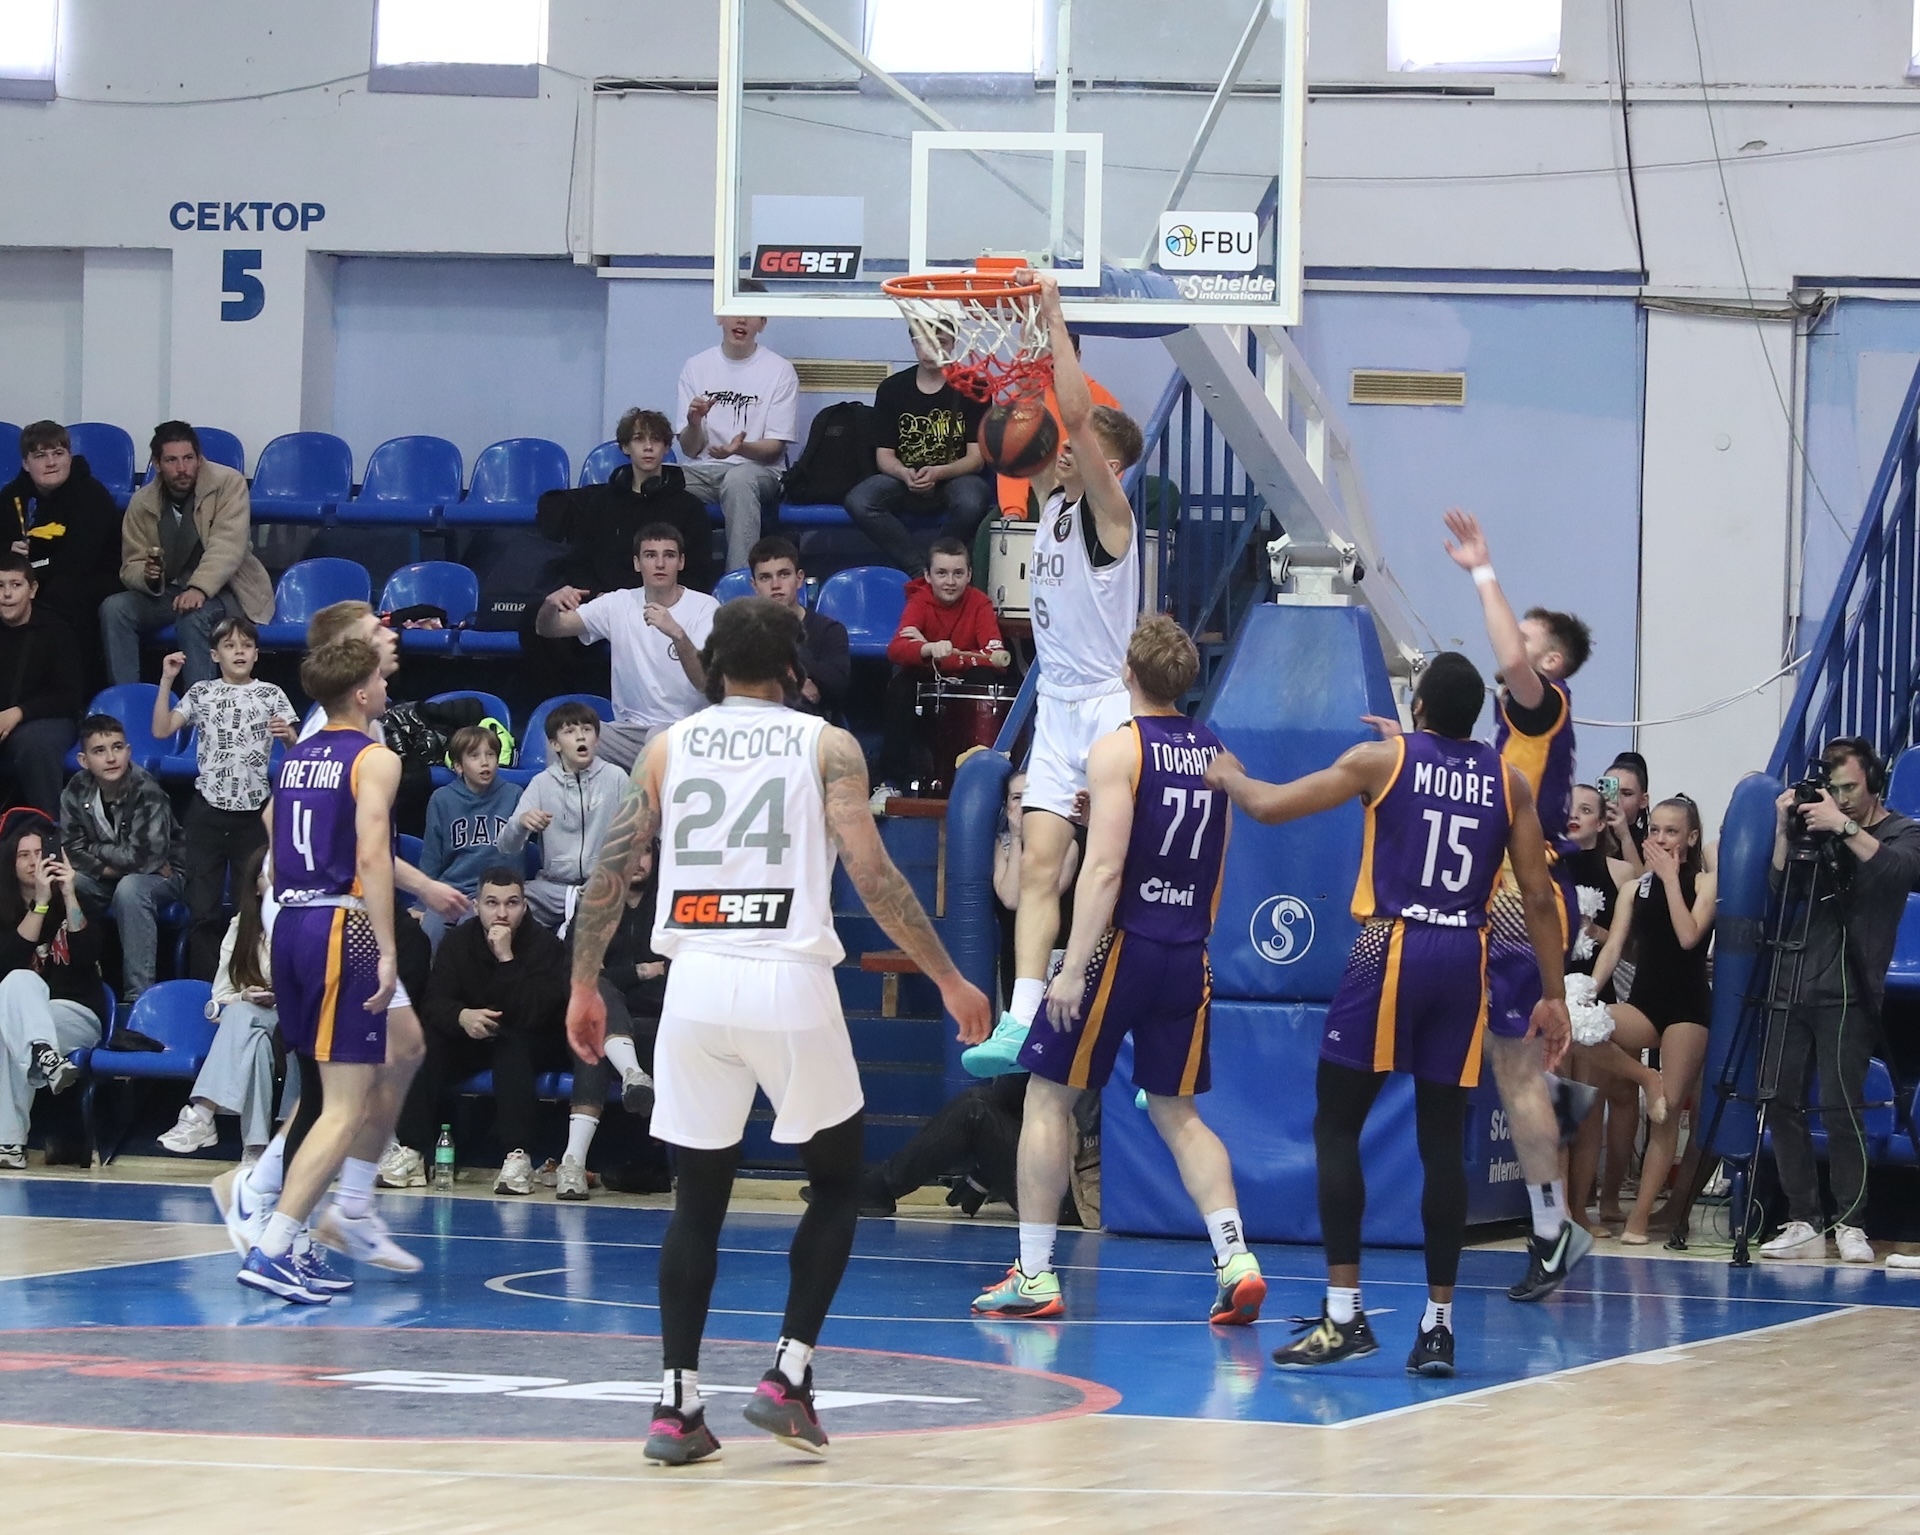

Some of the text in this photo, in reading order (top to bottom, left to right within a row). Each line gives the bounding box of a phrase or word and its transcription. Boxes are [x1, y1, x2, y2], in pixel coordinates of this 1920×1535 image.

[170, 202, 325, 231] СЕКТОР
[1201, 231, 1252, 254] FBU
[760, 251, 854, 273] GG.BET
[220, 249, 265, 321] 5
[1184, 274, 1275, 300] Schelde
[1198, 290, 1274, 300] international
[280, 760, 343, 789] TRETIAK
[1414, 762, 1495, 807] MOORE
[292, 801, 315, 871] 4
[672, 777, 791, 866] 24
[1159, 787, 1212, 860] 77
[1421, 809, 1479, 892] 15
[673, 894, 785, 923] GG.BET
[1488, 1157, 1524, 1184] interna
